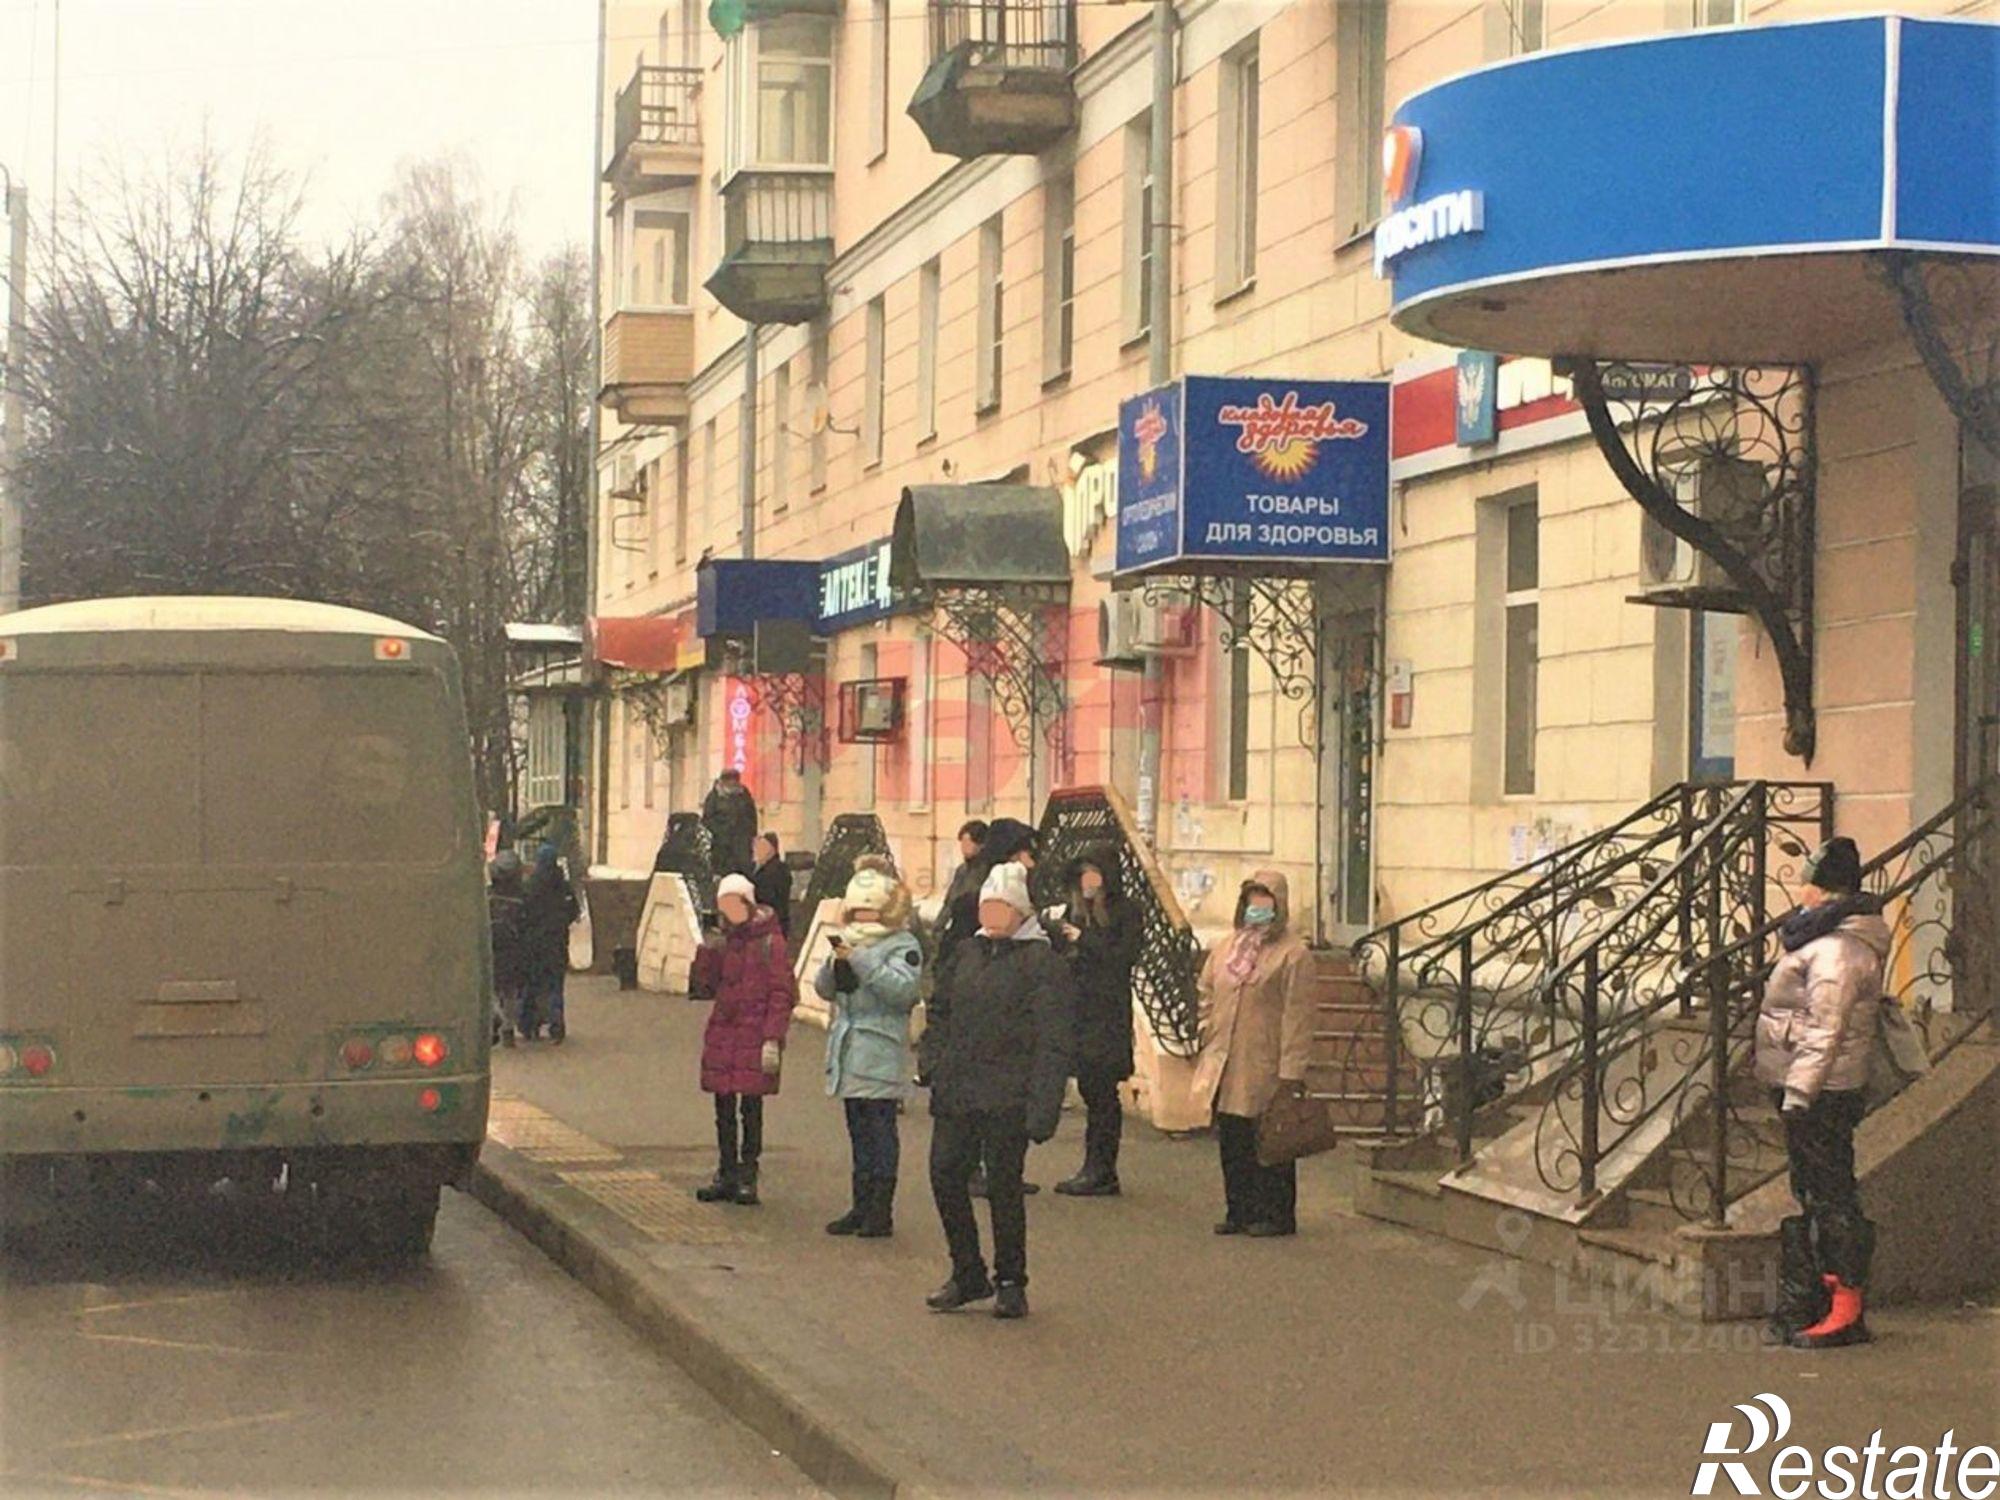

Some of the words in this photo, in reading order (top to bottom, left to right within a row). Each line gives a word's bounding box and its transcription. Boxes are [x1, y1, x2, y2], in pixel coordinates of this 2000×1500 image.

[1246, 494, 1339, 516] ТОВАРЫ
[1206, 522, 1252, 544] ДЛЯ
[1258, 524, 1378, 546] ЗДОРОВЬЯ
